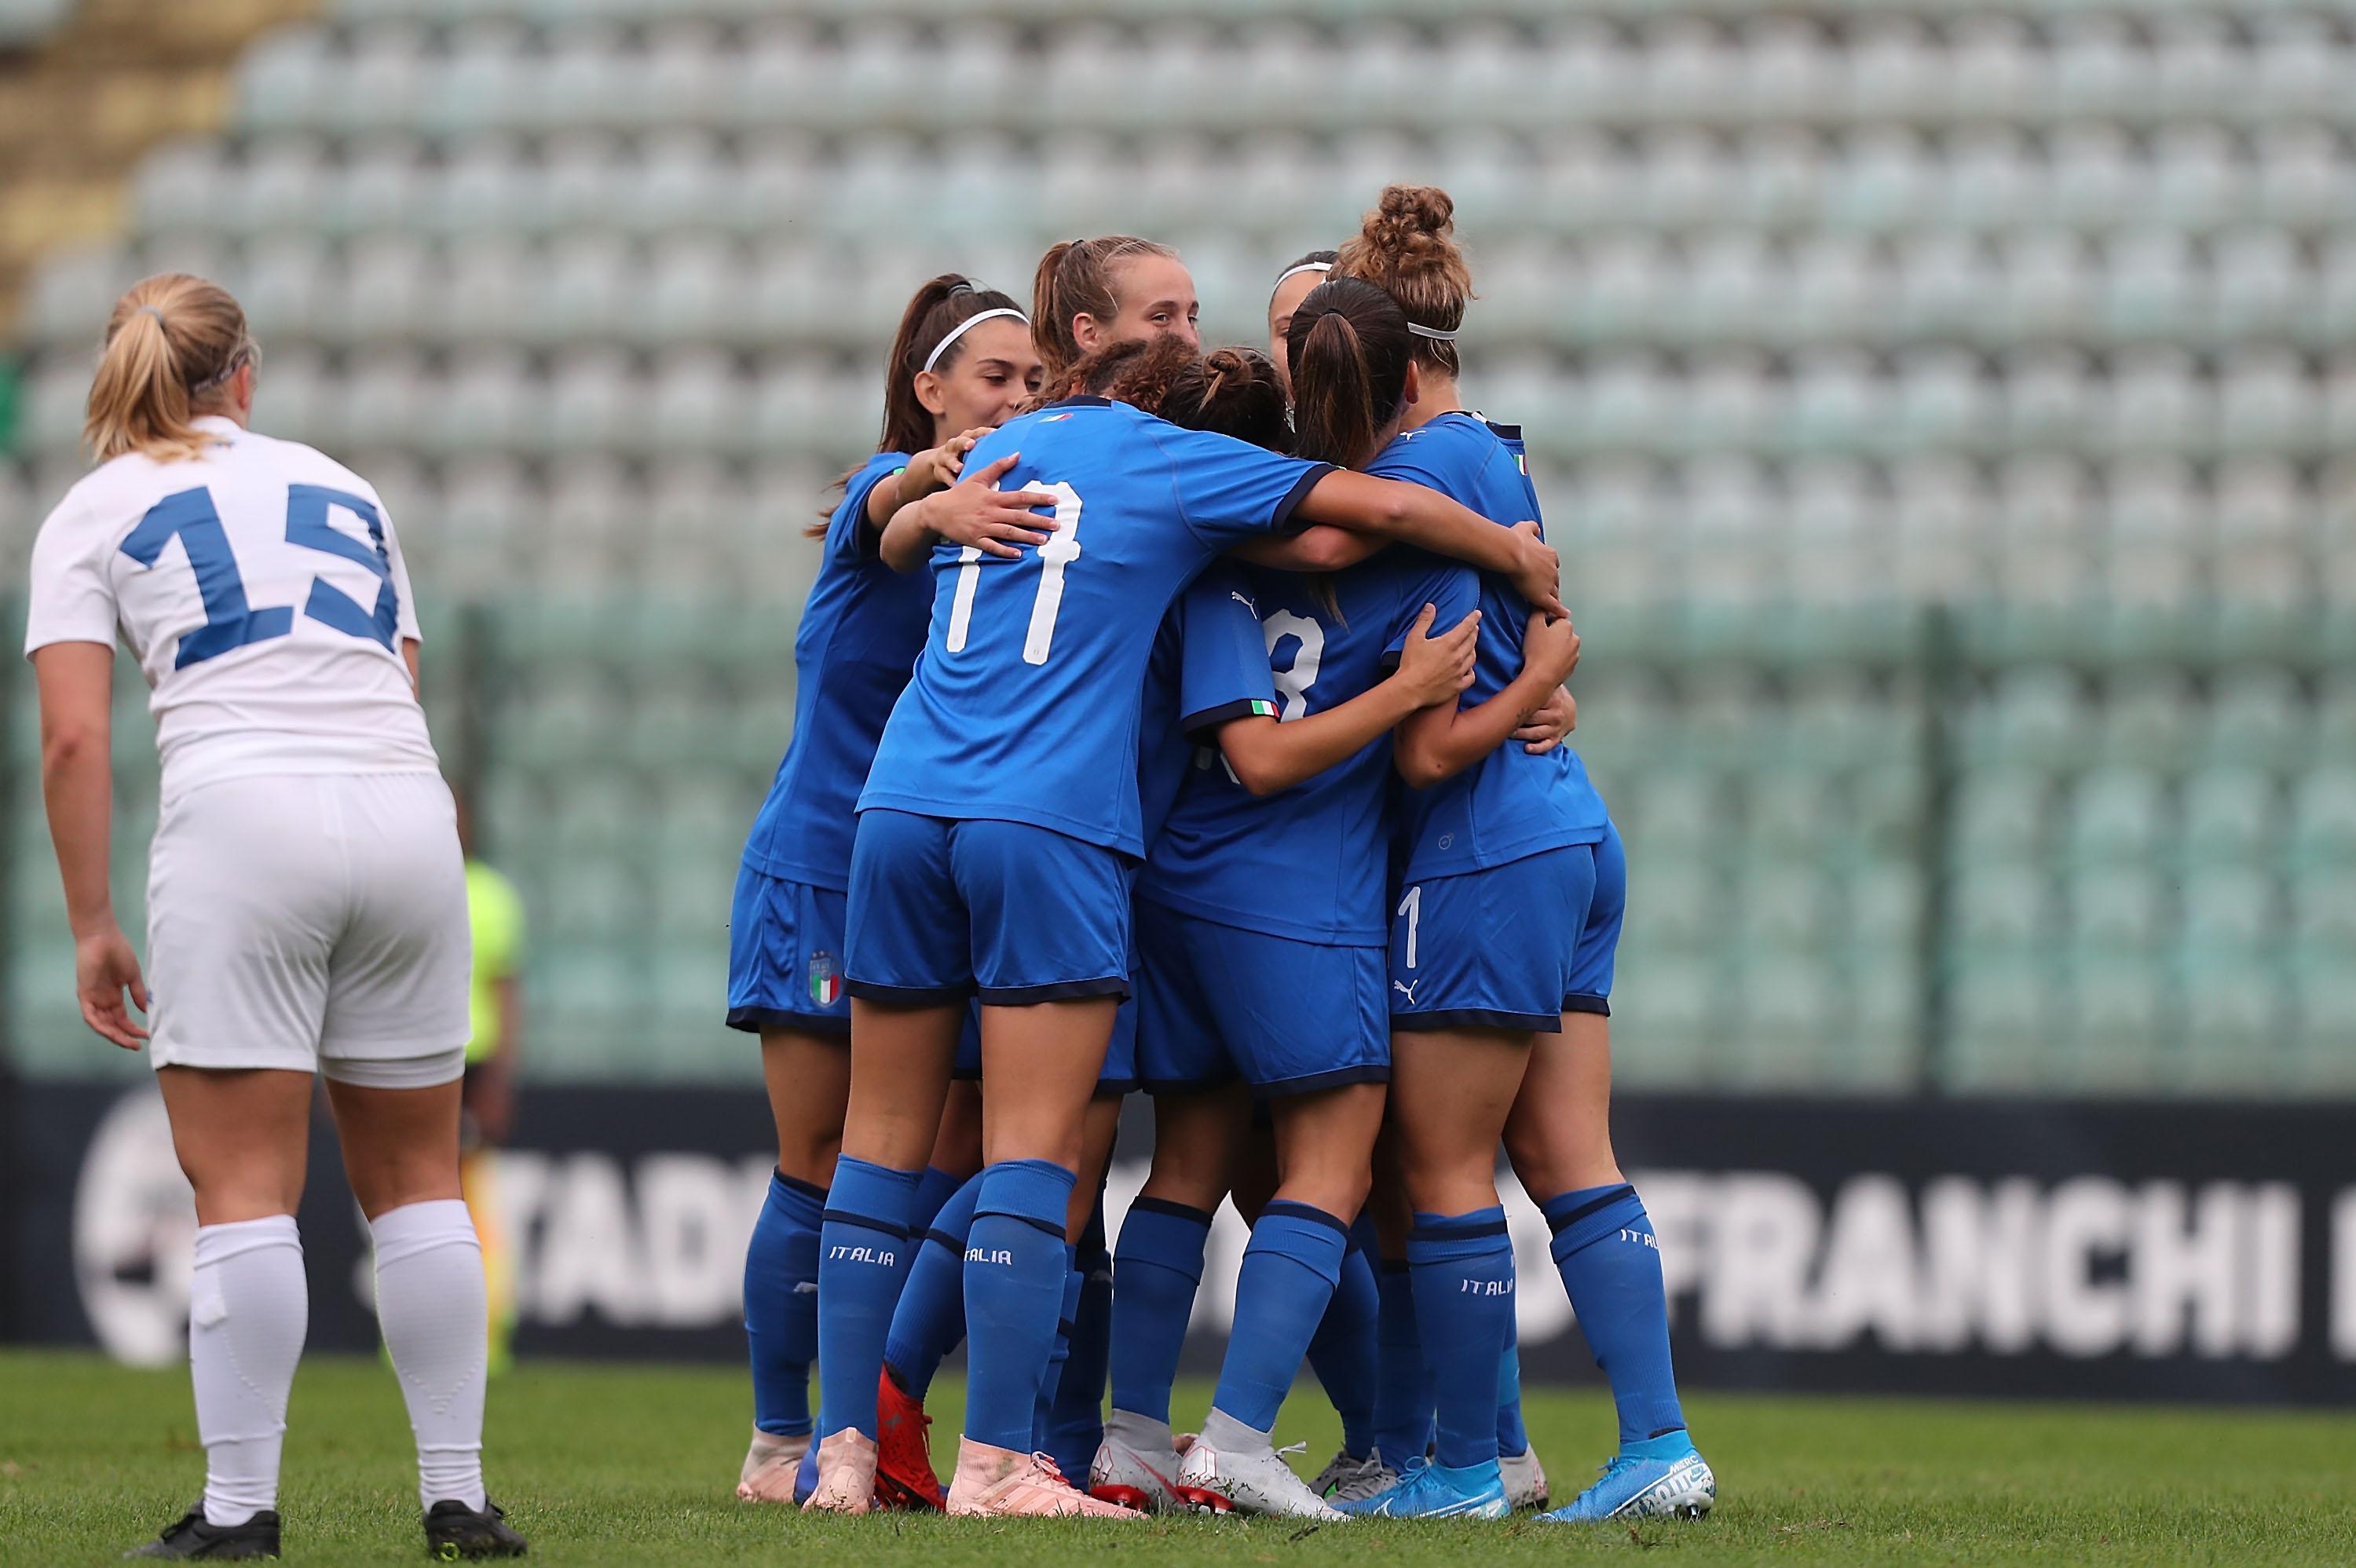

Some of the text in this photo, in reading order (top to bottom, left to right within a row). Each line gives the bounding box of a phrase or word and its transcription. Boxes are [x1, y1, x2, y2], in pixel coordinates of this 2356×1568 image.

[1620, 1229, 1659, 1249] ITAL
[829, 1246, 894, 1267] ITALIA
[964, 1248, 1012, 1266] TALIA
